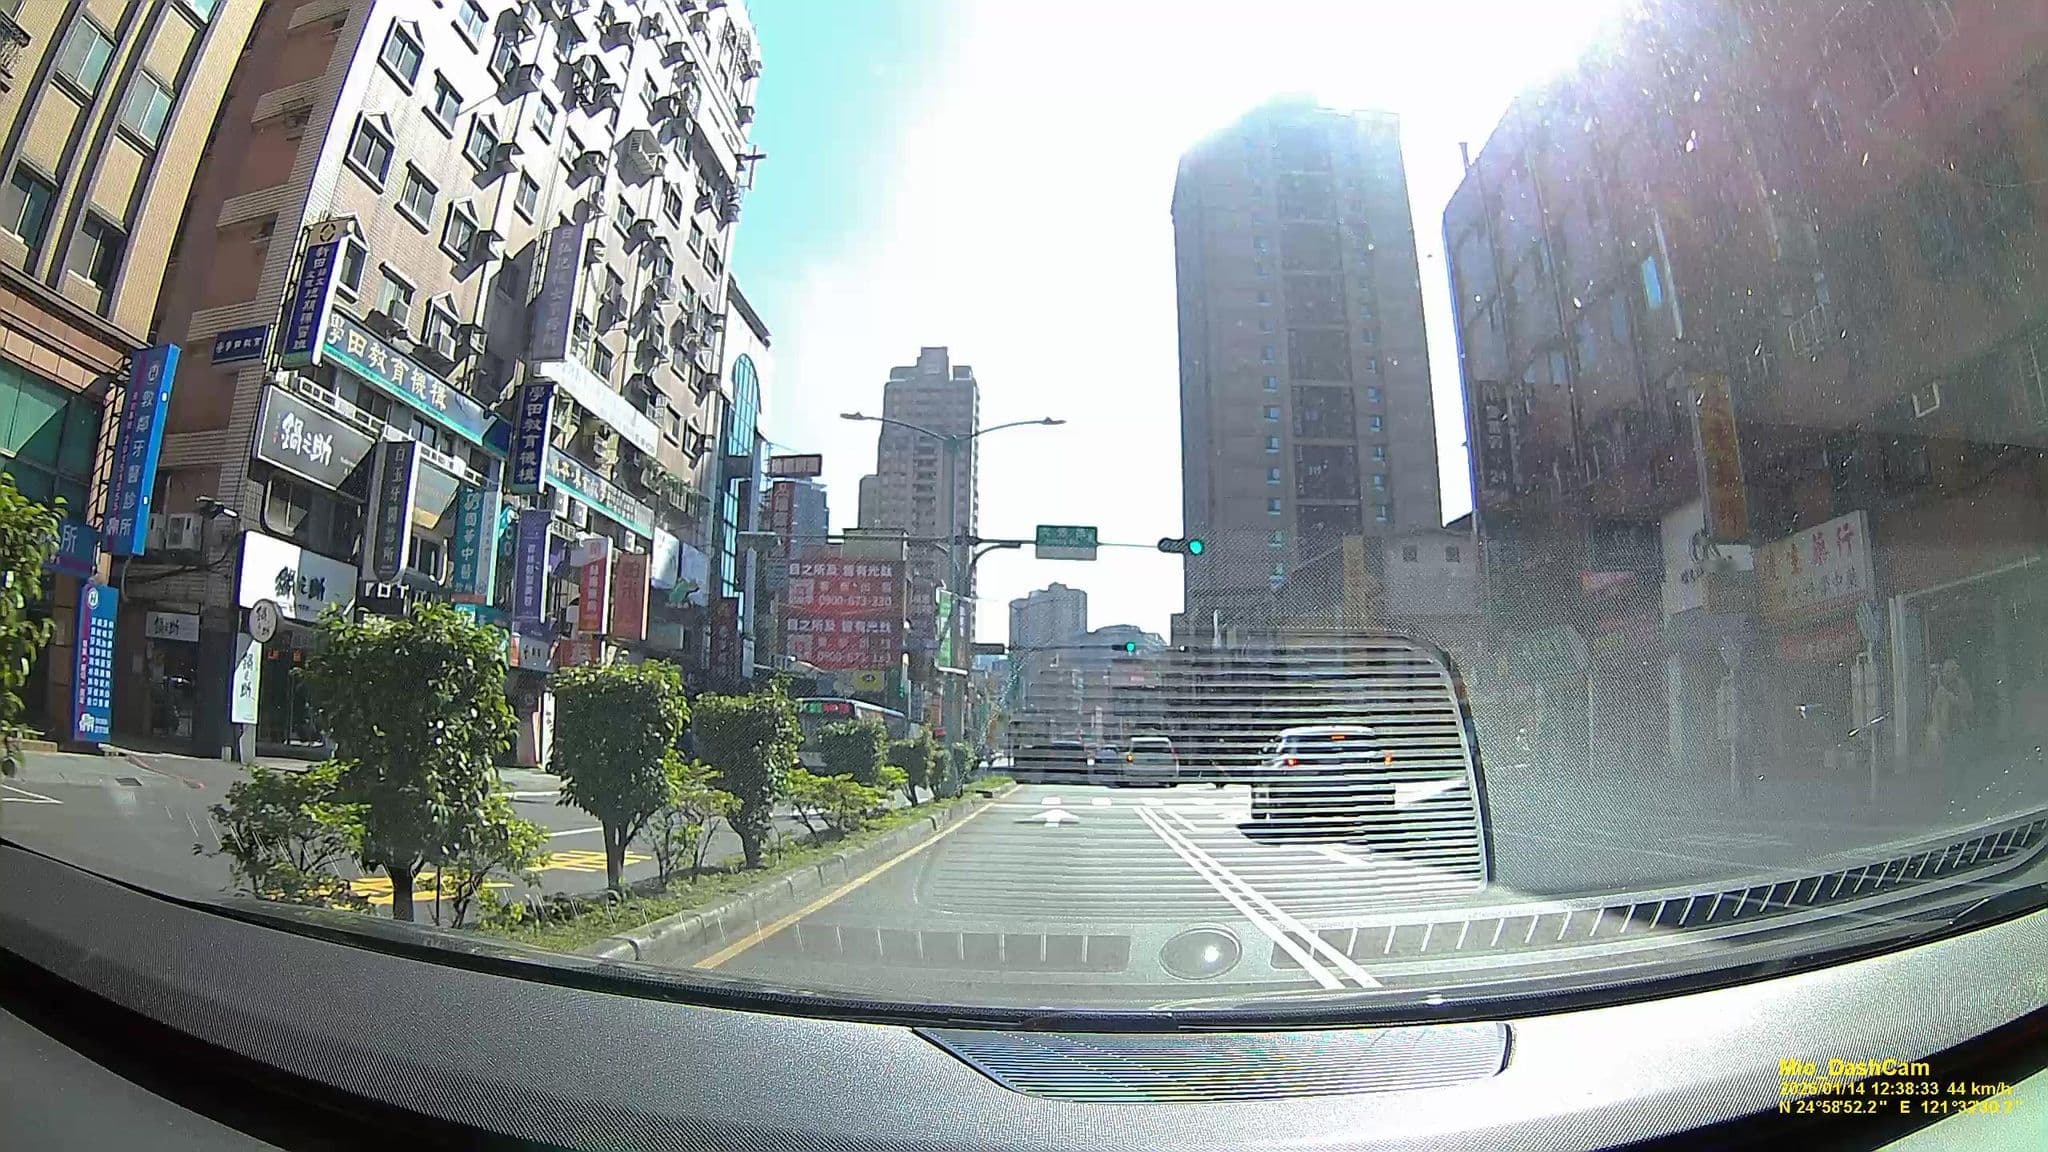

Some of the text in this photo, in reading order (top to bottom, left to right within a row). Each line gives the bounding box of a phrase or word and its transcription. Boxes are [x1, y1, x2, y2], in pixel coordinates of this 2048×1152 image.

[327, 313, 447, 410] 學田教育機構
[517, 386, 545, 484] 學田教育機構
